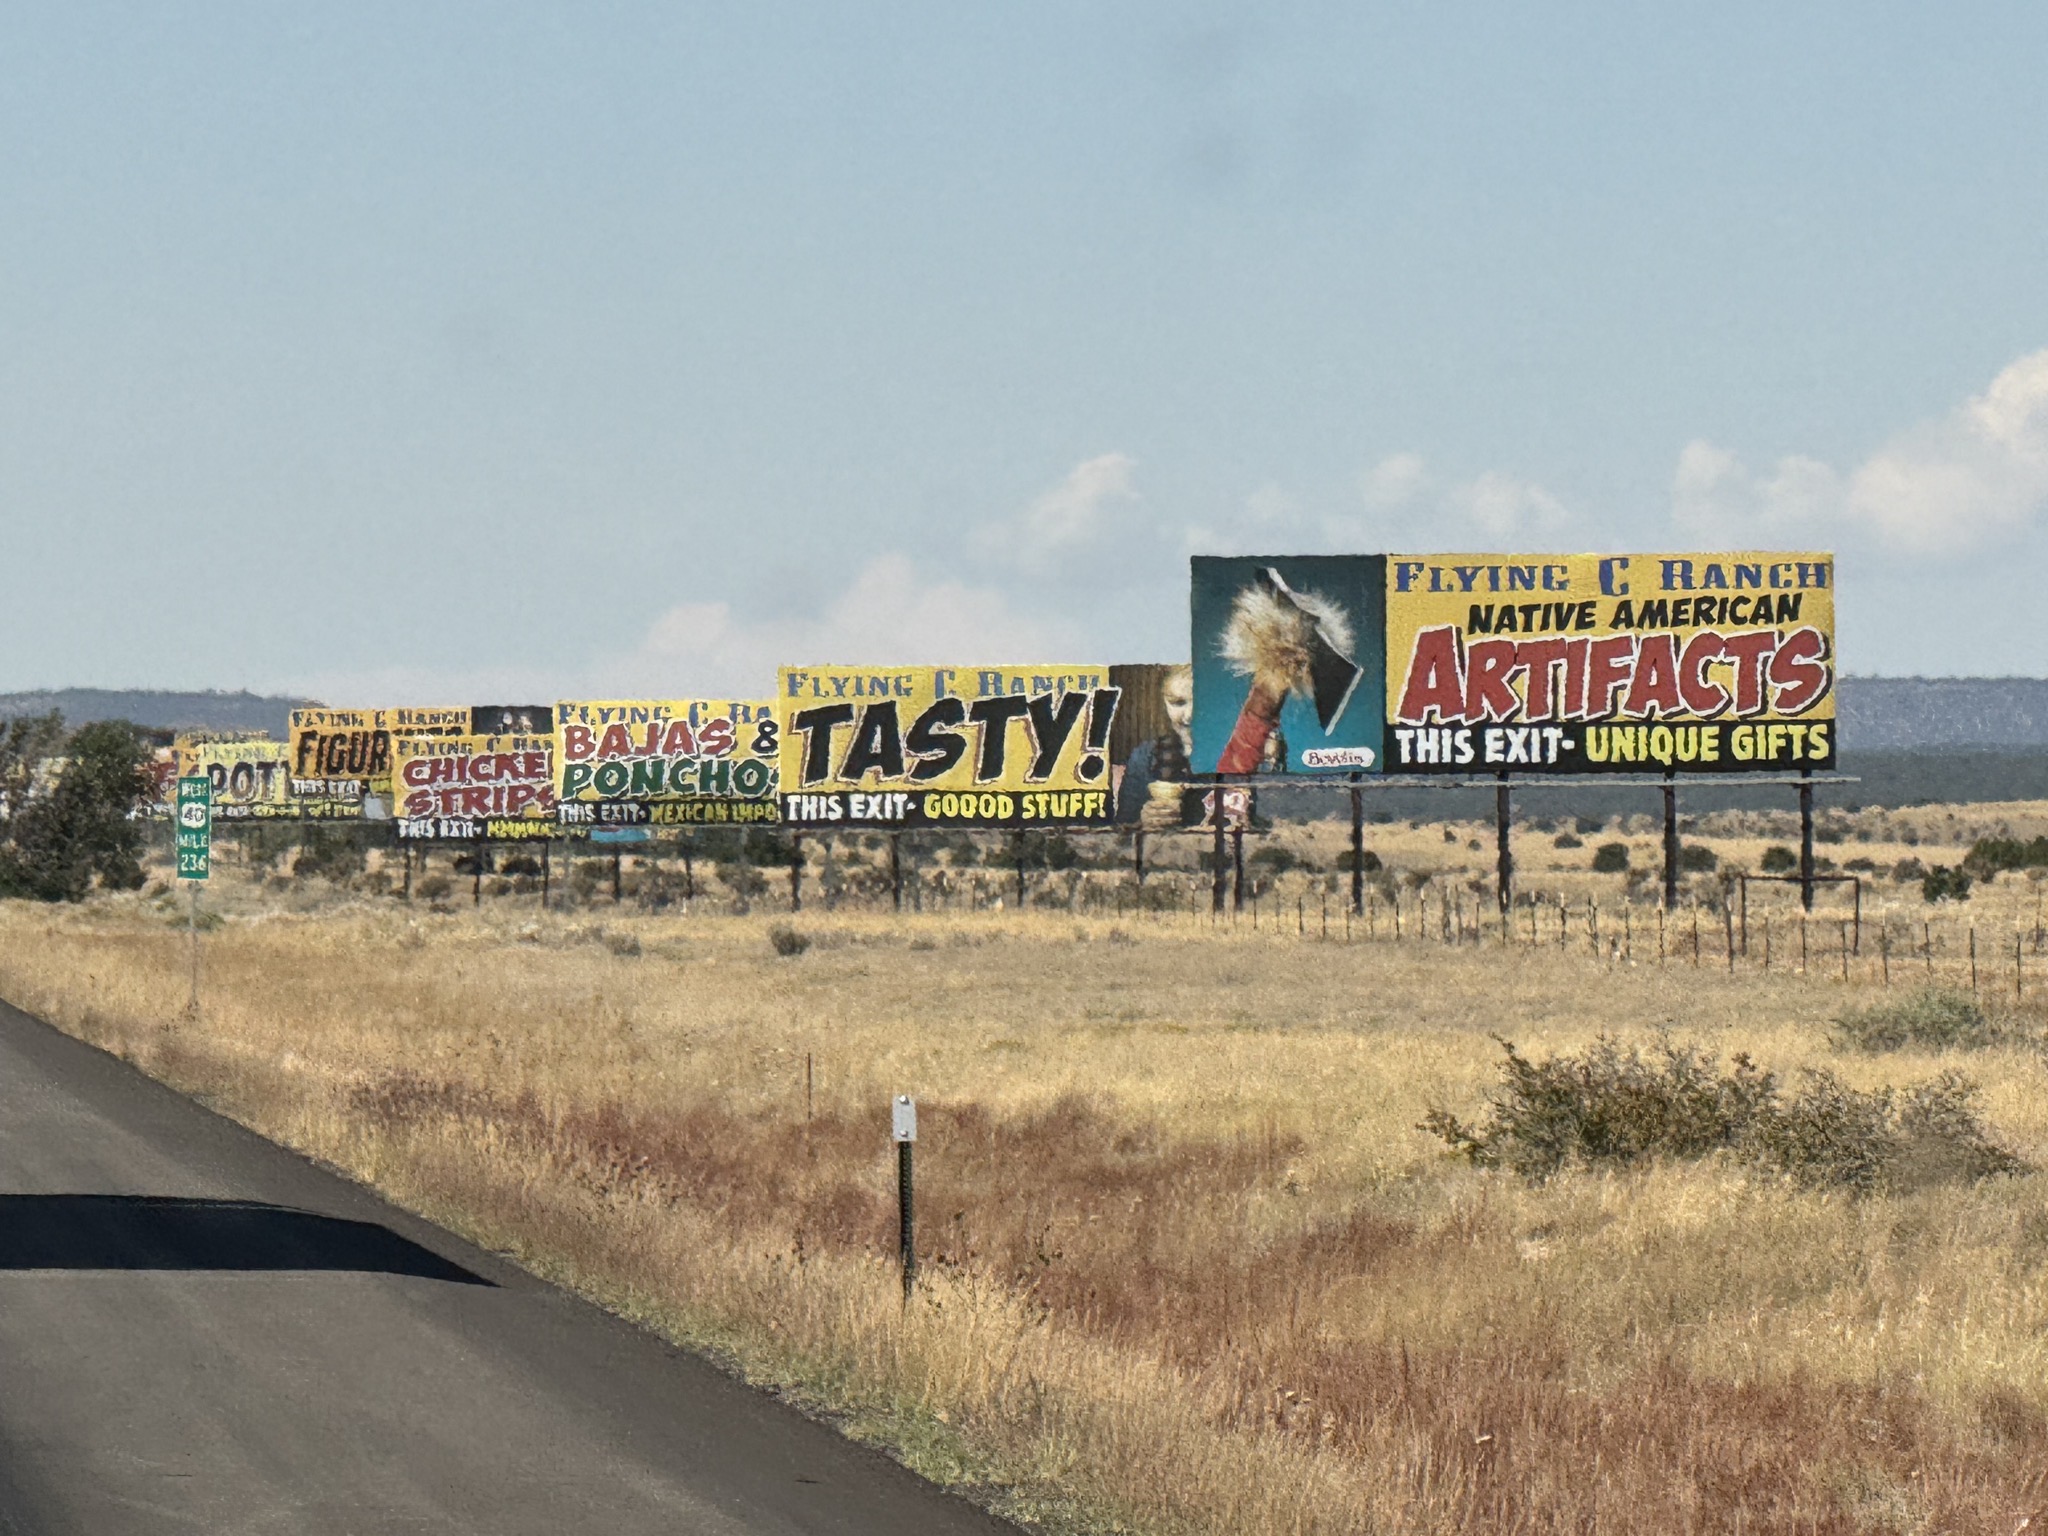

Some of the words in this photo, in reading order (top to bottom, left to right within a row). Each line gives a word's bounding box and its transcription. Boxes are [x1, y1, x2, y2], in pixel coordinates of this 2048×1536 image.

[1394, 562, 1570, 592] FLYING
[1599, 558, 1629, 596] C
[1659, 560, 1828, 590] RANCH
[1468, 600, 1597, 635] NATIVE
[1609, 592, 1803, 631] AMERICAN
[787, 673, 914, 698] FLYING
[935, 670, 956, 699] C
[979, 671, 1100, 696] RANCH
[1396, 624, 1832, 727] ARTIFACTS
[559, 703, 671, 726] FLYING
[564, 718, 738, 761] BAJAS
[788, 686, 1122, 789] TASTY!
[1395, 726, 1475, 764] THIS
[1484, 726, 1575, 764] EXIT-
[1585, 725, 1720, 766] UNIQUE
[1731, 723, 1829, 760] GIFTS
[562, 758, 780, 801] PONCHO
[558, 803, 595, 823] THIS
[651, 803, 728, 824] MEXICAN
[787, 793, 843, 820] THIS
[849, 793, 916, 820] EXIT-
[923, 793, 1014, 819] GOOOD
[1022, 792, 1106, 819] STUFF!
[179, 833, 208, 849] MILE
[397, 819, 435, 838] THIS
[181, 853, 207, 871] 236
